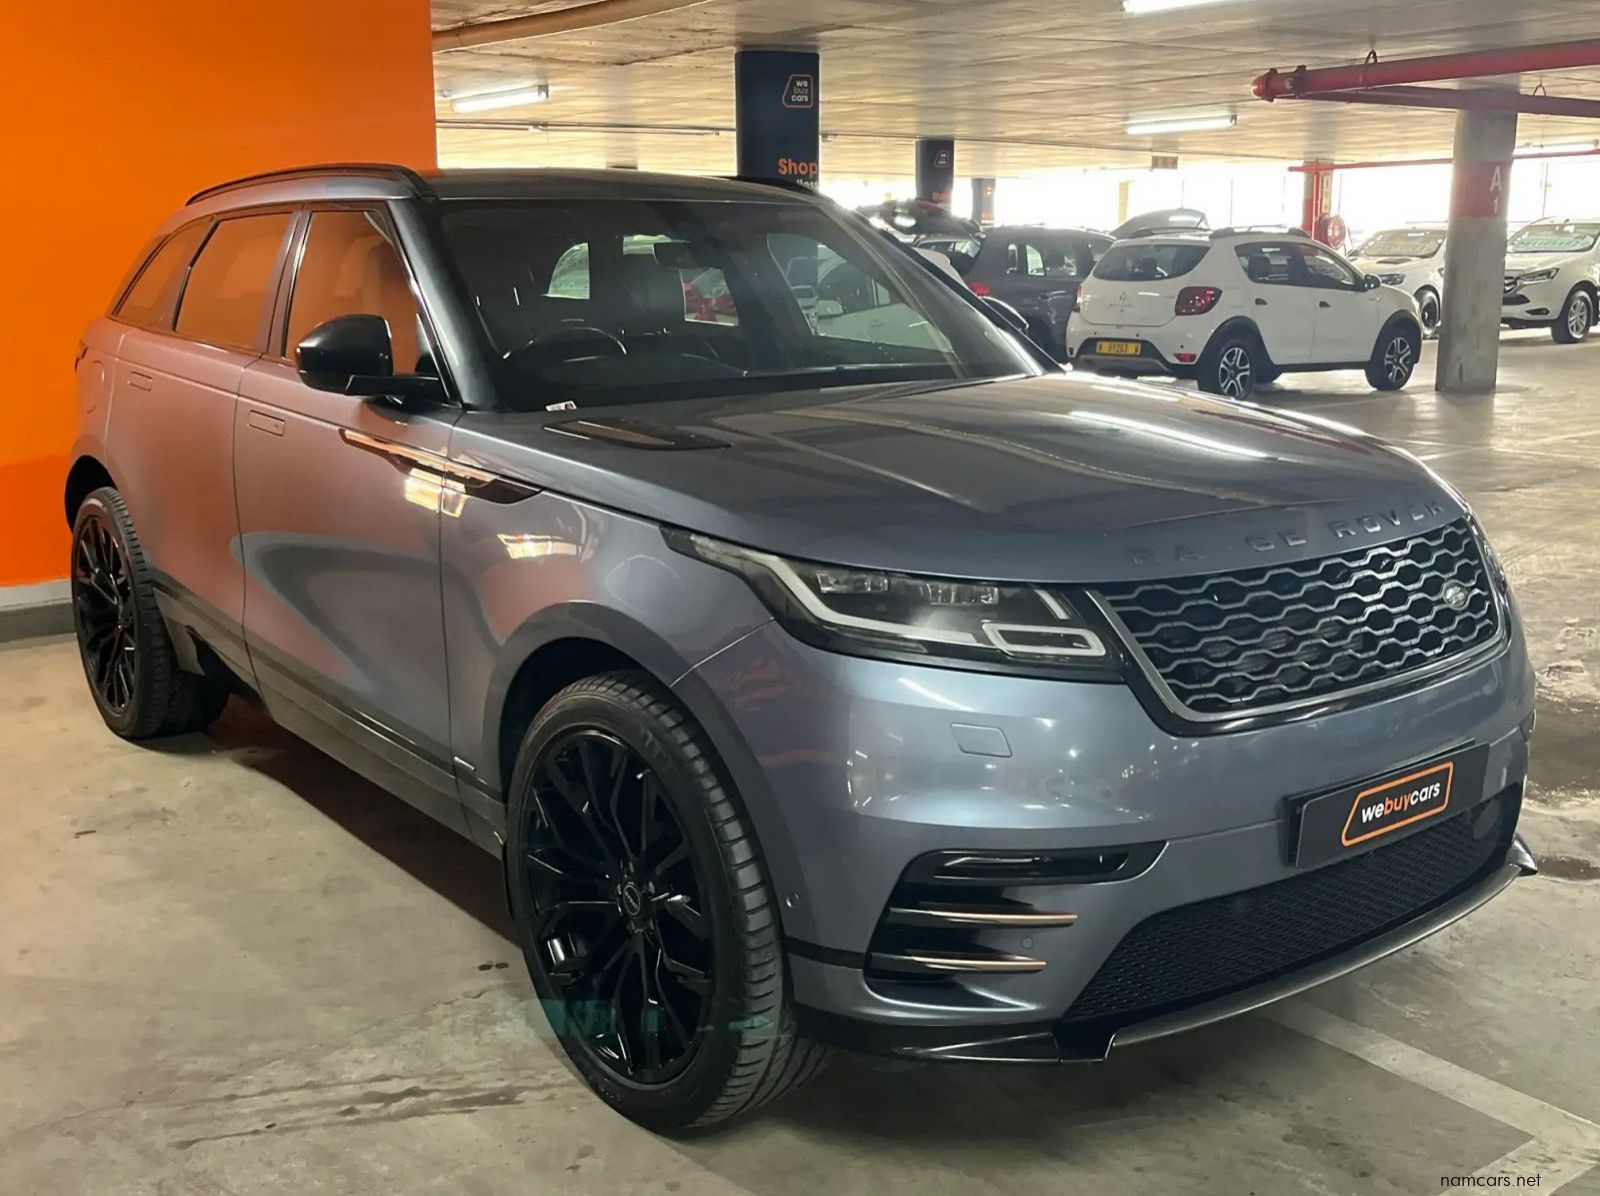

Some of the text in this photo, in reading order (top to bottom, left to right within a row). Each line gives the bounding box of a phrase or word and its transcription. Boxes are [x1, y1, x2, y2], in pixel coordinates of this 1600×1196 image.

[795, 80, 809, 88] we
[791, 94, 809, 102] cars
[778, 158, 818, 178] Shop
[1490, 165, 1502, 192] A
[1328, 502, 1444, 539] ROVER
[1361, 782, 1441, 823] webuycars
